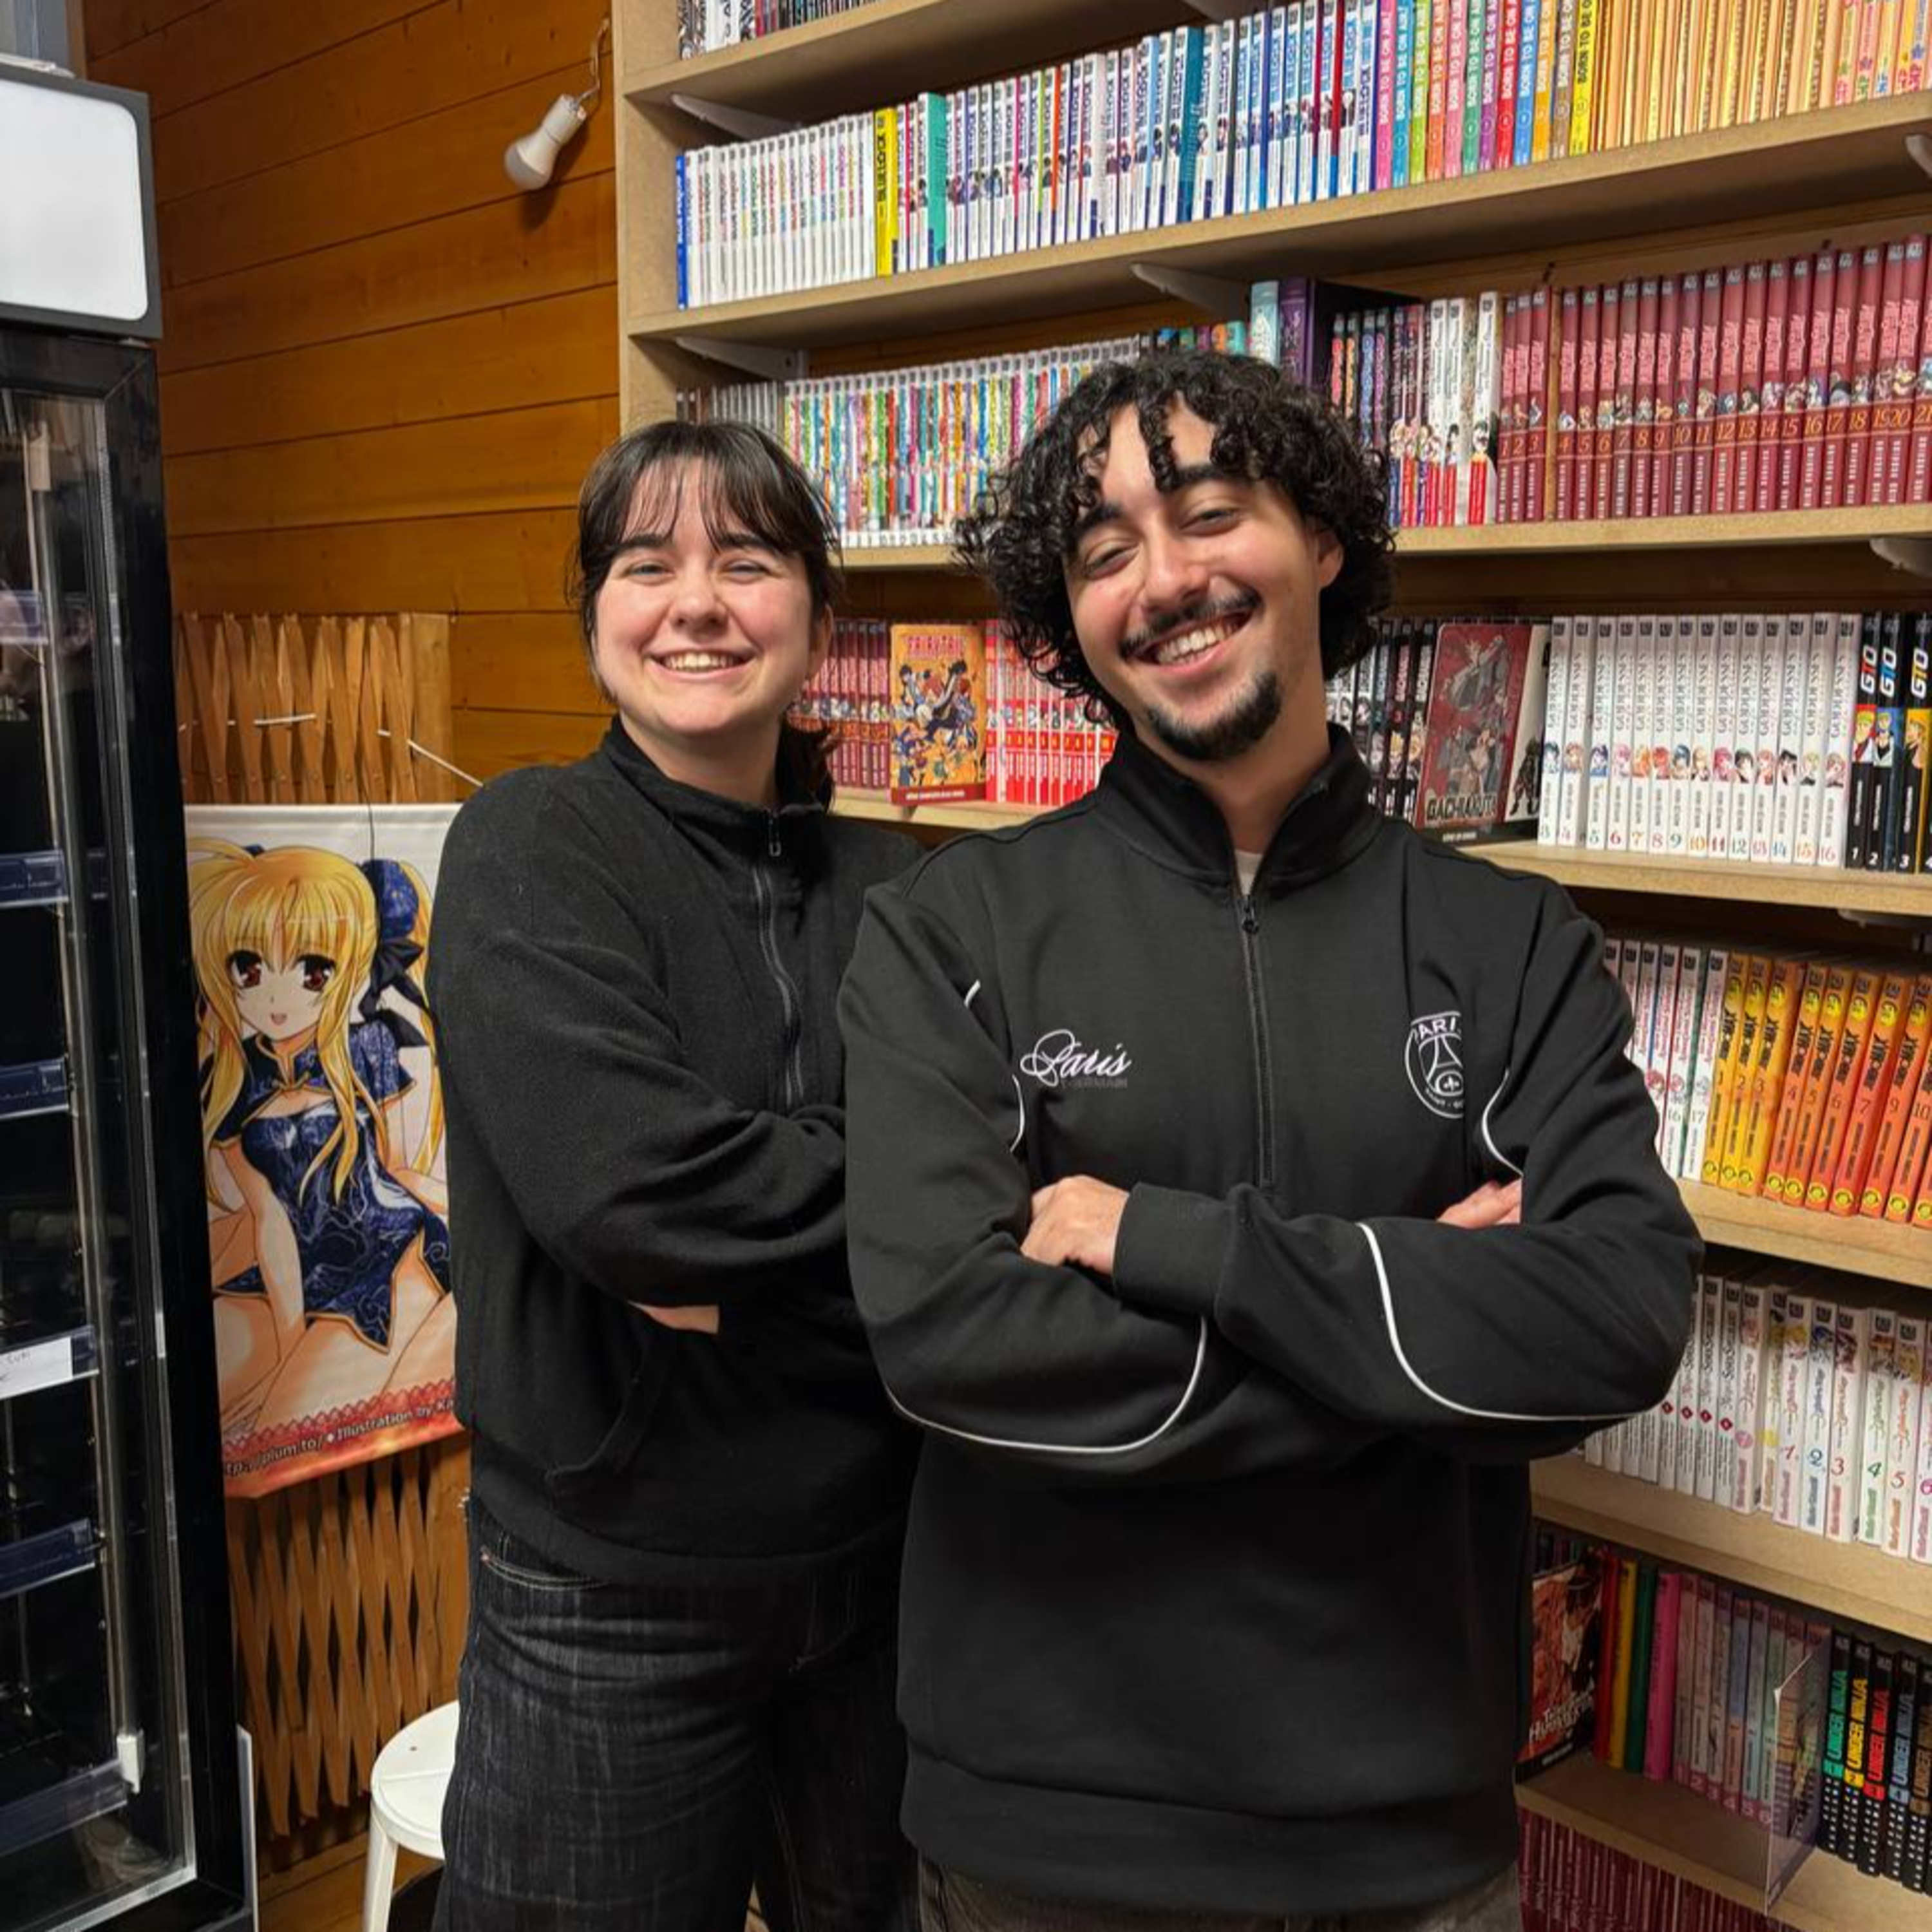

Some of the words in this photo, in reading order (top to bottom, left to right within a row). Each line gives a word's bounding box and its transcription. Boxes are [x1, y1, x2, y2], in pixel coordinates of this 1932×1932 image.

[1506, 8, 1516, 26] ON
[1525, 6, 1534, 23] ON
[1582, 12, 1591, 26] BE
[1452, 22, 1461, 39] ON
[1470, 18, 1480, 35] ON
[1487, 15, 1496, 31] ON
[1561, 16, 1572, 31] BE
[1486, 34, 1495, 50] BE
[1505, 30, 1515, 44] BE
[1524, 26, 1533, 42] BE
[1580, 31, 1590, 47] TO
[1381, 38, 1391, 55] ON
[1397, 34, 1406, 51] ON
[1451, 42, 1461, 57] BE
[1469, 38, 1479, 53] BE
[1539, 41, 1549, 55] TO
[1560, 35, 1571, 51] TO
[1432, 46, 1443, 61] BE
[1484, 53, 1493, 68] TO
[1504, 48, 1514, 62] TO
[1522, 45, 1533, 60] TO
[1380, 59, 1390, 74] BE
[1397, 54, 1406, 68] BE
[1450, 61, 1459, 75] TO
[1468, 57, 1478, 71] TO
[1397, 71, 1406, 86] TO
[1415, 68, 1424, 82] TO
[1432, 64, 1442, 79] TO
[1380, 75, 1389, 91] TO
[1805, 416, 1823, 434] 16
[1826, 413, 1844, 431] 17
[1849, 410, 1866, 430] 18
[1889, 407, 1911, 427] 20
[1676, 425, 1690, 444] 10
[1696, 426, 1710, 444] 11
[1718, 422, 1734, 440] 12
[1739, 421, 1756, 439] 13
[1761, 419, 1777, 437] 14
[1783, 418, 1798, 437] 15
[1529, 435, 1539, 452] 3
[1560, 437, 1569, 453] 4
[1579, 435, 1589, 452] 5
[1599, 435, 1610, 451] 6
[1618, 431, 1629, 447] 7
[1637, 430, 1649, 446] 8
[1654, 430, 1665, 447] 9
[1502, 440, 1508, 456] 1
[1514, 439, 1524, 457] 2
[1861, 645, 1877, 694] GTO
[1880, 647, 1897, 697] GTO
[1911, 647, 1929, 699] GTO
[1610, 830, 1620, 845] 6
[1631, 831, 1643, 846] 7
[1652, 833, 1663, 848] 8
[1670, 834, 1682, 849] 9
[1731, 838, 1747, 855] 12
[1795, 841, 1812, 859] 15
[1819, 846, 1835, 862] 16
[1851, 847, 1859, 860] 1
[1869, 852, 1879, 865] 2
[1899, 855, 1909, 867] 3
[1417, 1016, 1458, 1040] ARI
[1019, 1029, 1132, 1087] Paris
[1739, 1075, 1745, 1089] 2
[1757, 1079, 1765, 1092] 3
[1860, 1099, 1870, 1114] 7
[1889, 1098, 1899, 1113] 9
[1914, 1103, 1930, 1119] 10
[1692, 1110, 1705, 1123] 17
[1807, 1448, 1823, 1466] 2
[1831, 1457, 1844, 1476] 3
[1868, 1462, 1882, 1477] 4
[1890, 1471, 1906, 1489] 5
[1851, 1678, 1868, 1721] NINJA
[1871, 1689, 1889, 1733] NINJA
[1897, 1694, 1913, 1736] NINJA
[1827, 1713, 1844, 1760] UNDER
[1846, 1723, 1864, 1770] UNDER
[1868, 1734, 1885, 1782] UNDER
[1892, 1737, 1911, 1786] UNDER
[1913, 1749, 1931, 1798] UNDER
